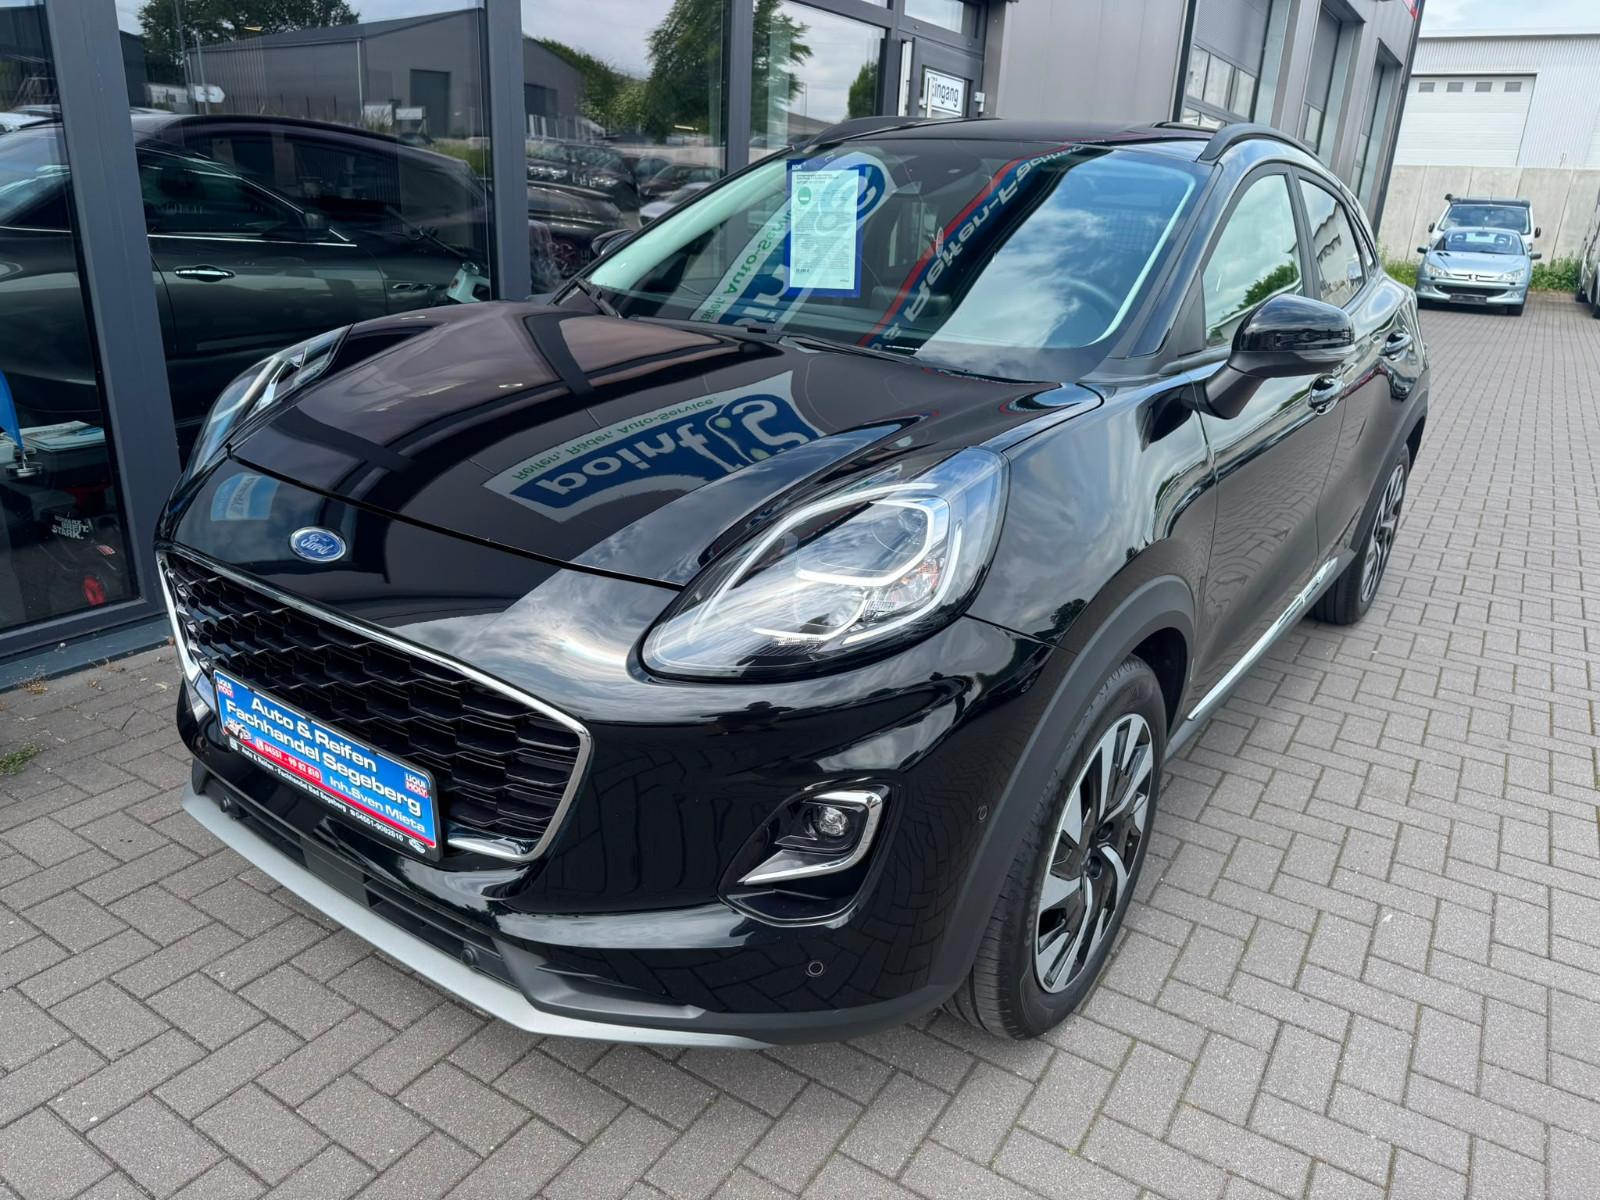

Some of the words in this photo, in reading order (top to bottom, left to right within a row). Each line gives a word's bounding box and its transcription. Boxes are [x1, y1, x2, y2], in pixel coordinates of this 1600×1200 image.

[300, 533, 335, 556] Ford
[225, 698, 320, 763] Fachhandel
[322, 751, 422, 817] Segeberg
[251, 698, 295, 731] Auto
[297, 721, 313, 740] &
[314, 729, 377, 773] Reifen
[385, 804, 426, 834] Mieta
